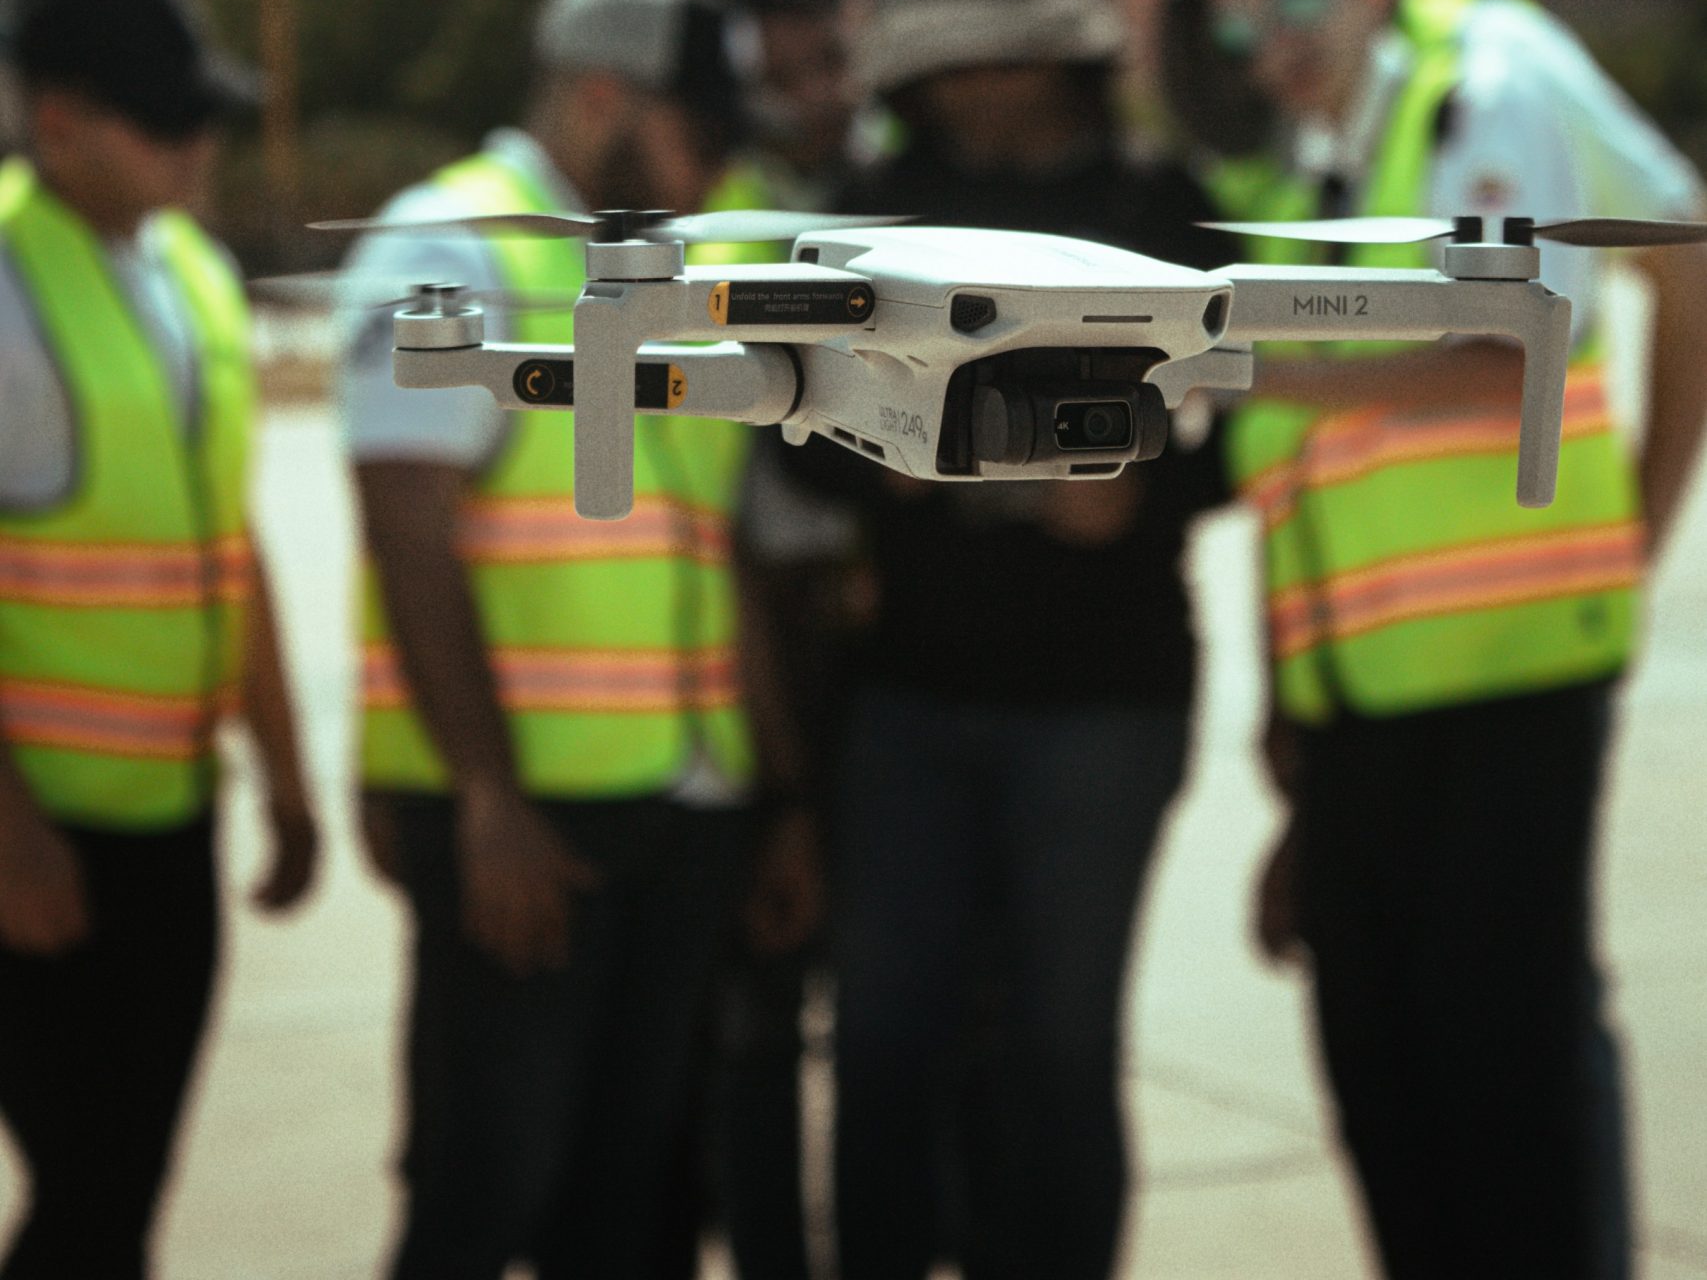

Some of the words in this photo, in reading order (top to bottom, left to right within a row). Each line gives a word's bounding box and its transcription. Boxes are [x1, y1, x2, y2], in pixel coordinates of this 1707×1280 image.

[714, 294, 721, 311] 1
[1293, 295, 1347, 316] MINI
[1354, 295, 1368, 316] 2
[672, 380, 682, 397] 2
[1057, 421, 1069, 431] 4K
